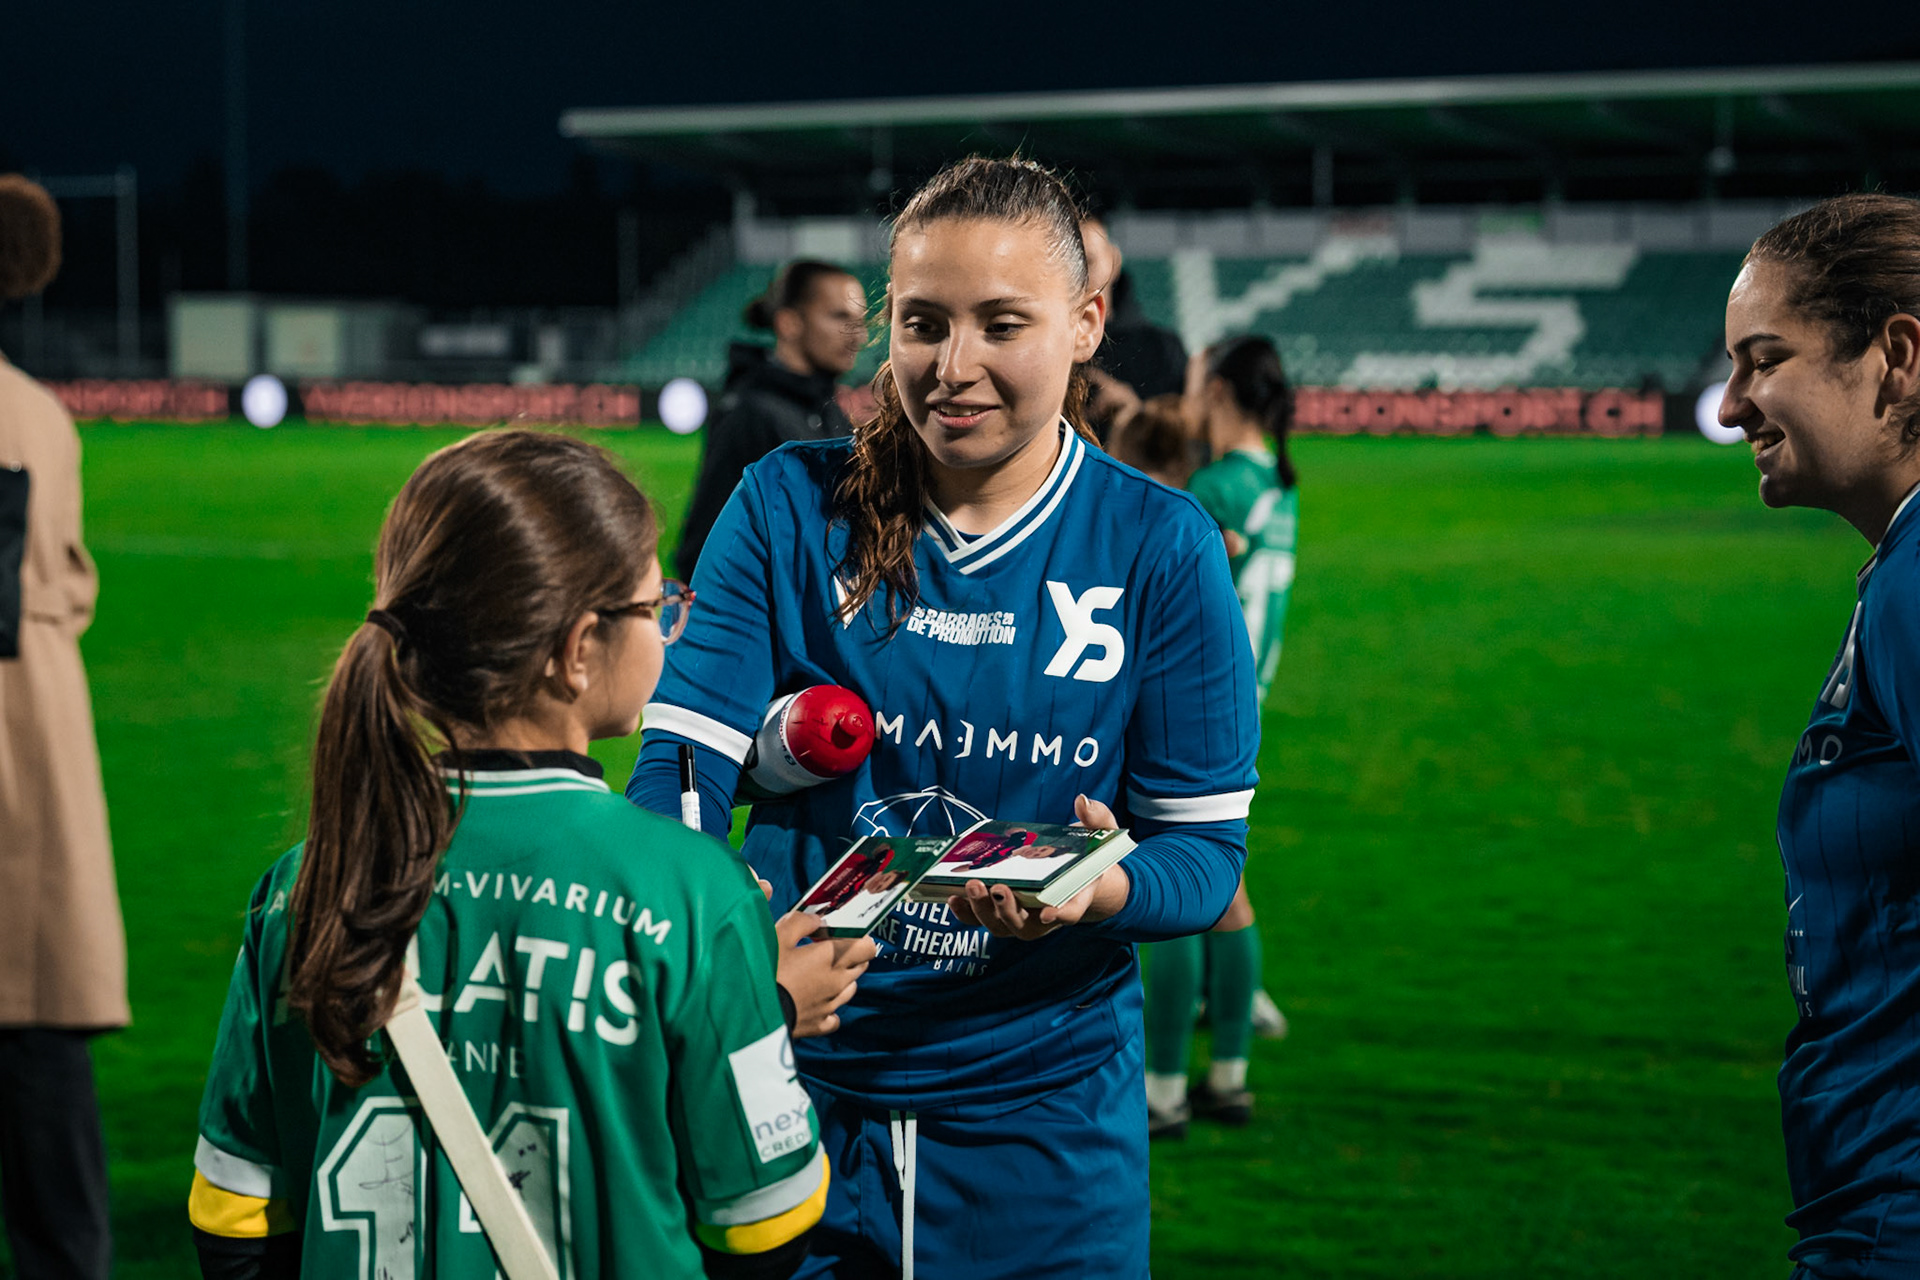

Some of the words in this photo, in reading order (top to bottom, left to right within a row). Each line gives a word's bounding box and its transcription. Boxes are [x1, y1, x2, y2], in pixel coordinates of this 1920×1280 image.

[906, 615, 926, 635] DE
[927, 621, 1017, 646] PROMOTION
[1043, 580, 1125, 683] YS
[903, 923, 991, 959] THERMAL
